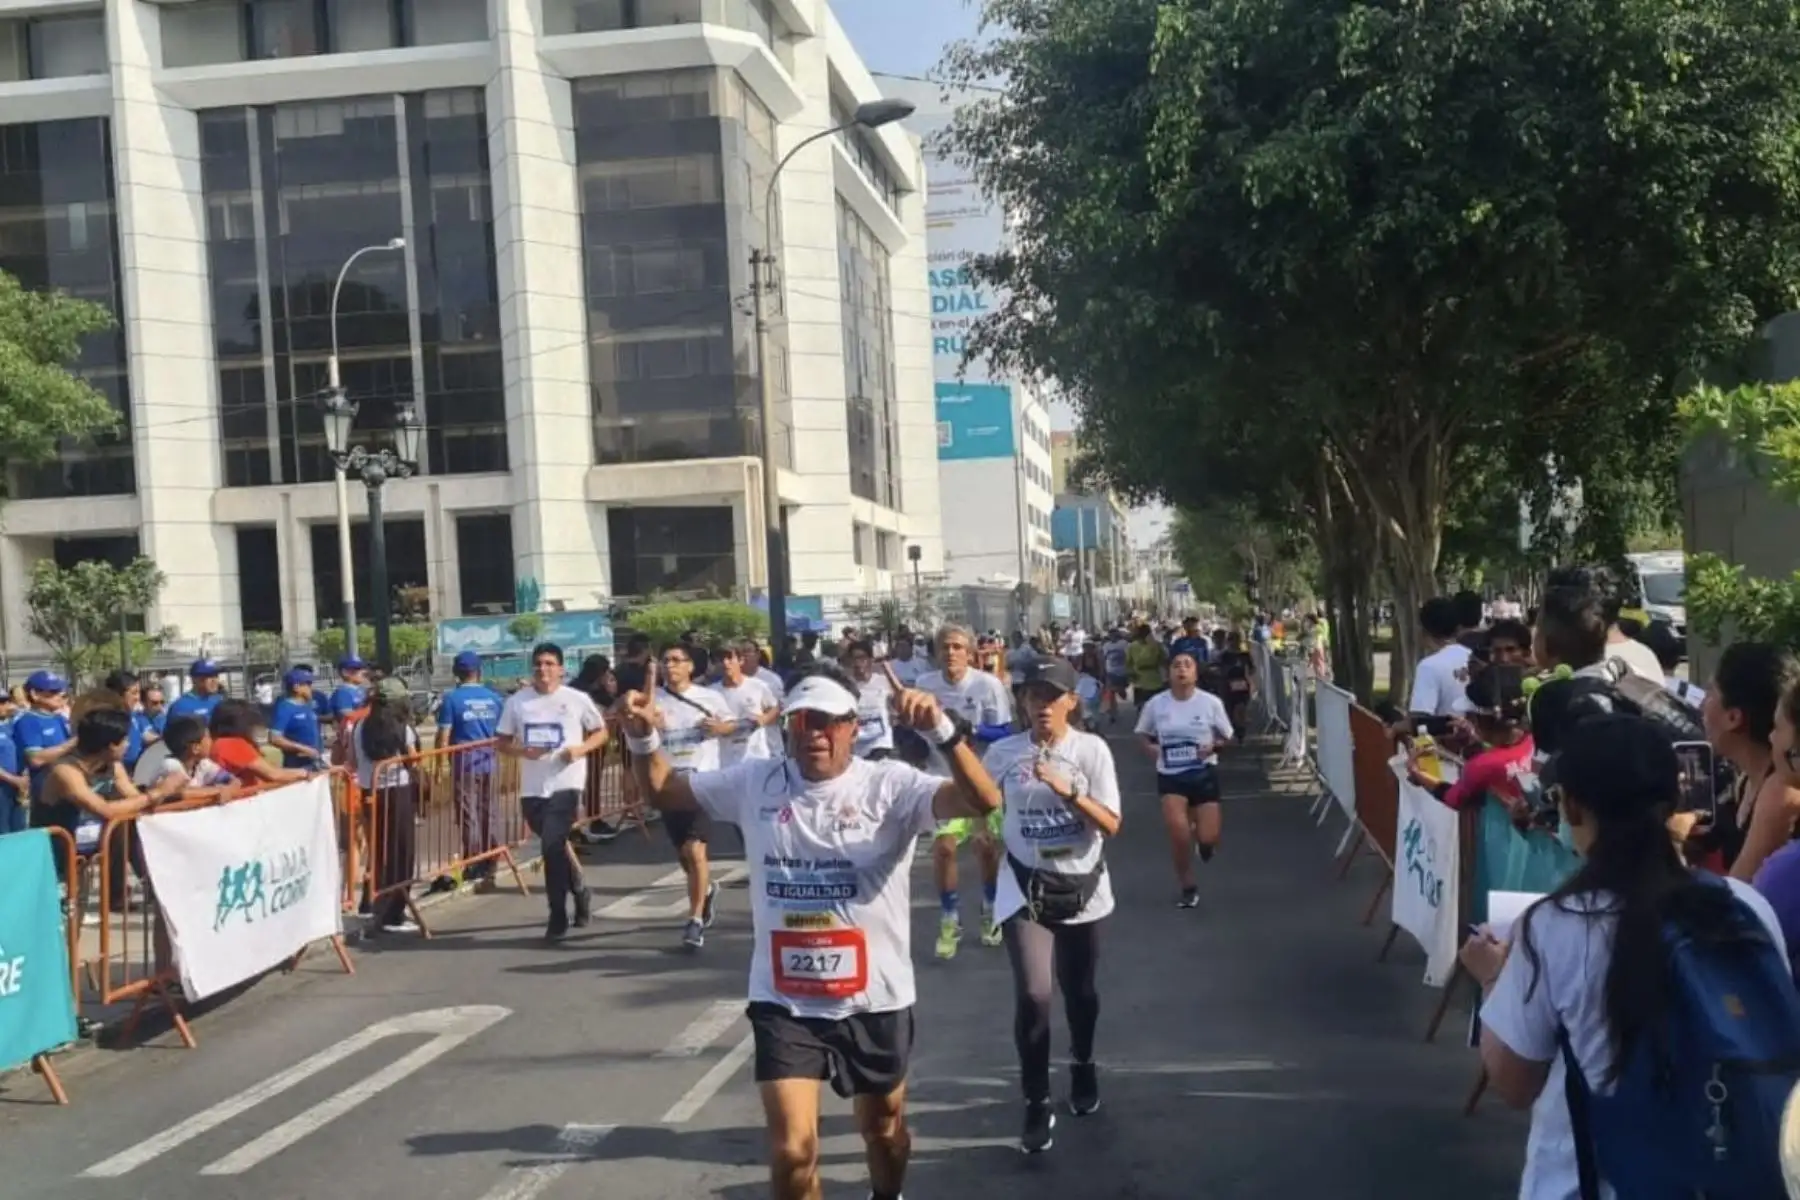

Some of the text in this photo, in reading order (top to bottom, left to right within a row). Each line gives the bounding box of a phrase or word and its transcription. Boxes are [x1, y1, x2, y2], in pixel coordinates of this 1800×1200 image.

[932, 290, 988, 313] DIAL
[783, 886, 852, 897] IGUALDAD
[791, 954, 842, 972] 2217
